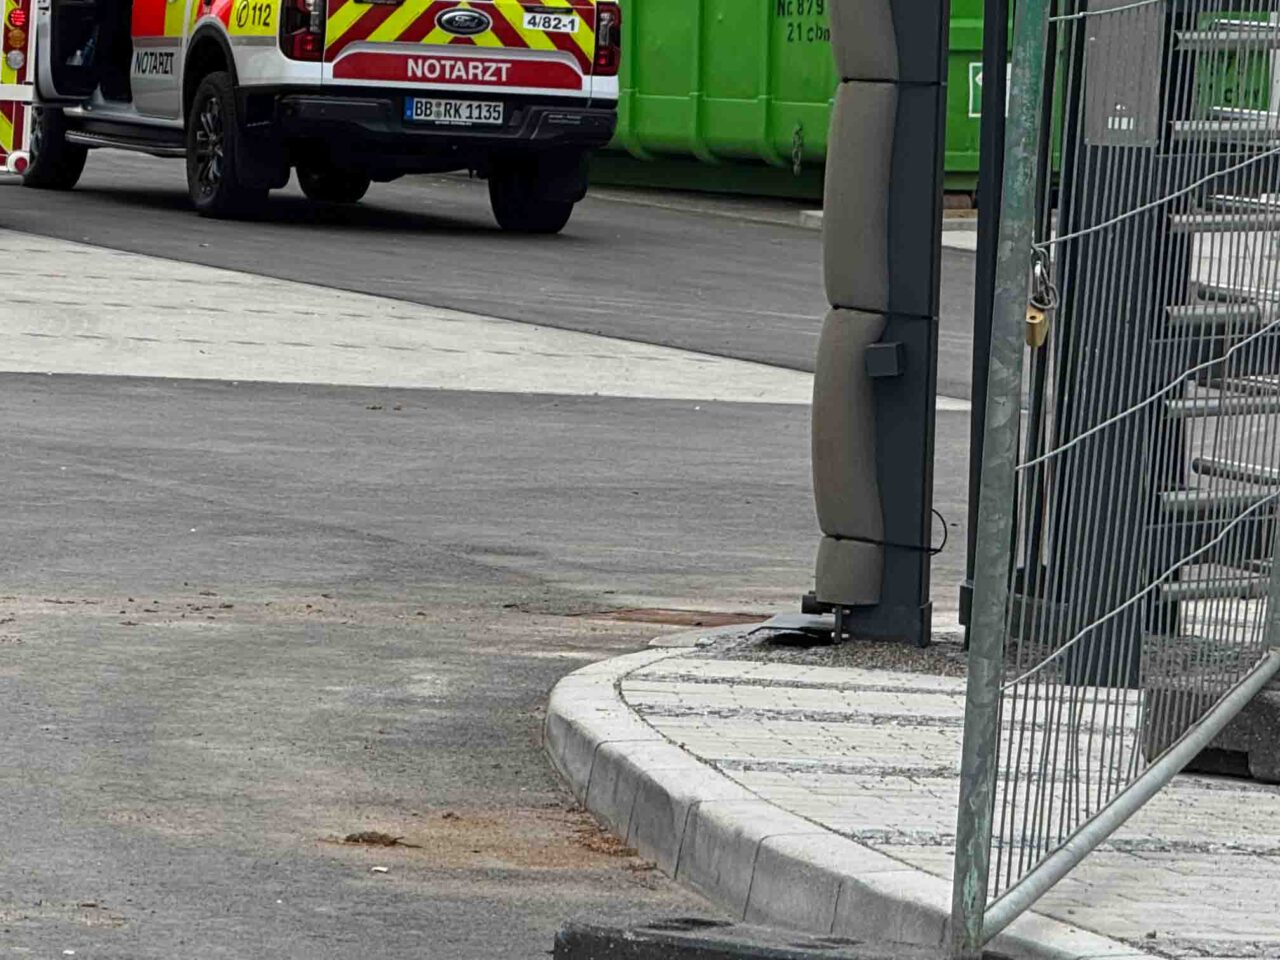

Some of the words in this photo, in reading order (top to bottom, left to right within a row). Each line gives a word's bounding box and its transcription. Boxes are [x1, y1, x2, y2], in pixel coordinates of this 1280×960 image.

[252, 4, 271, 27] 112
[526, 15, 576, 32] 4/82-1
[787, 22, 802, 42] 21
[134, 51, 174, 75] NOTARZT
[407, 58, 512, 82] NOTARZT
[415, 100, 433, 118] BB
[444, 102, 461, 119] RK
[466, 103, 501, 121] 1135
